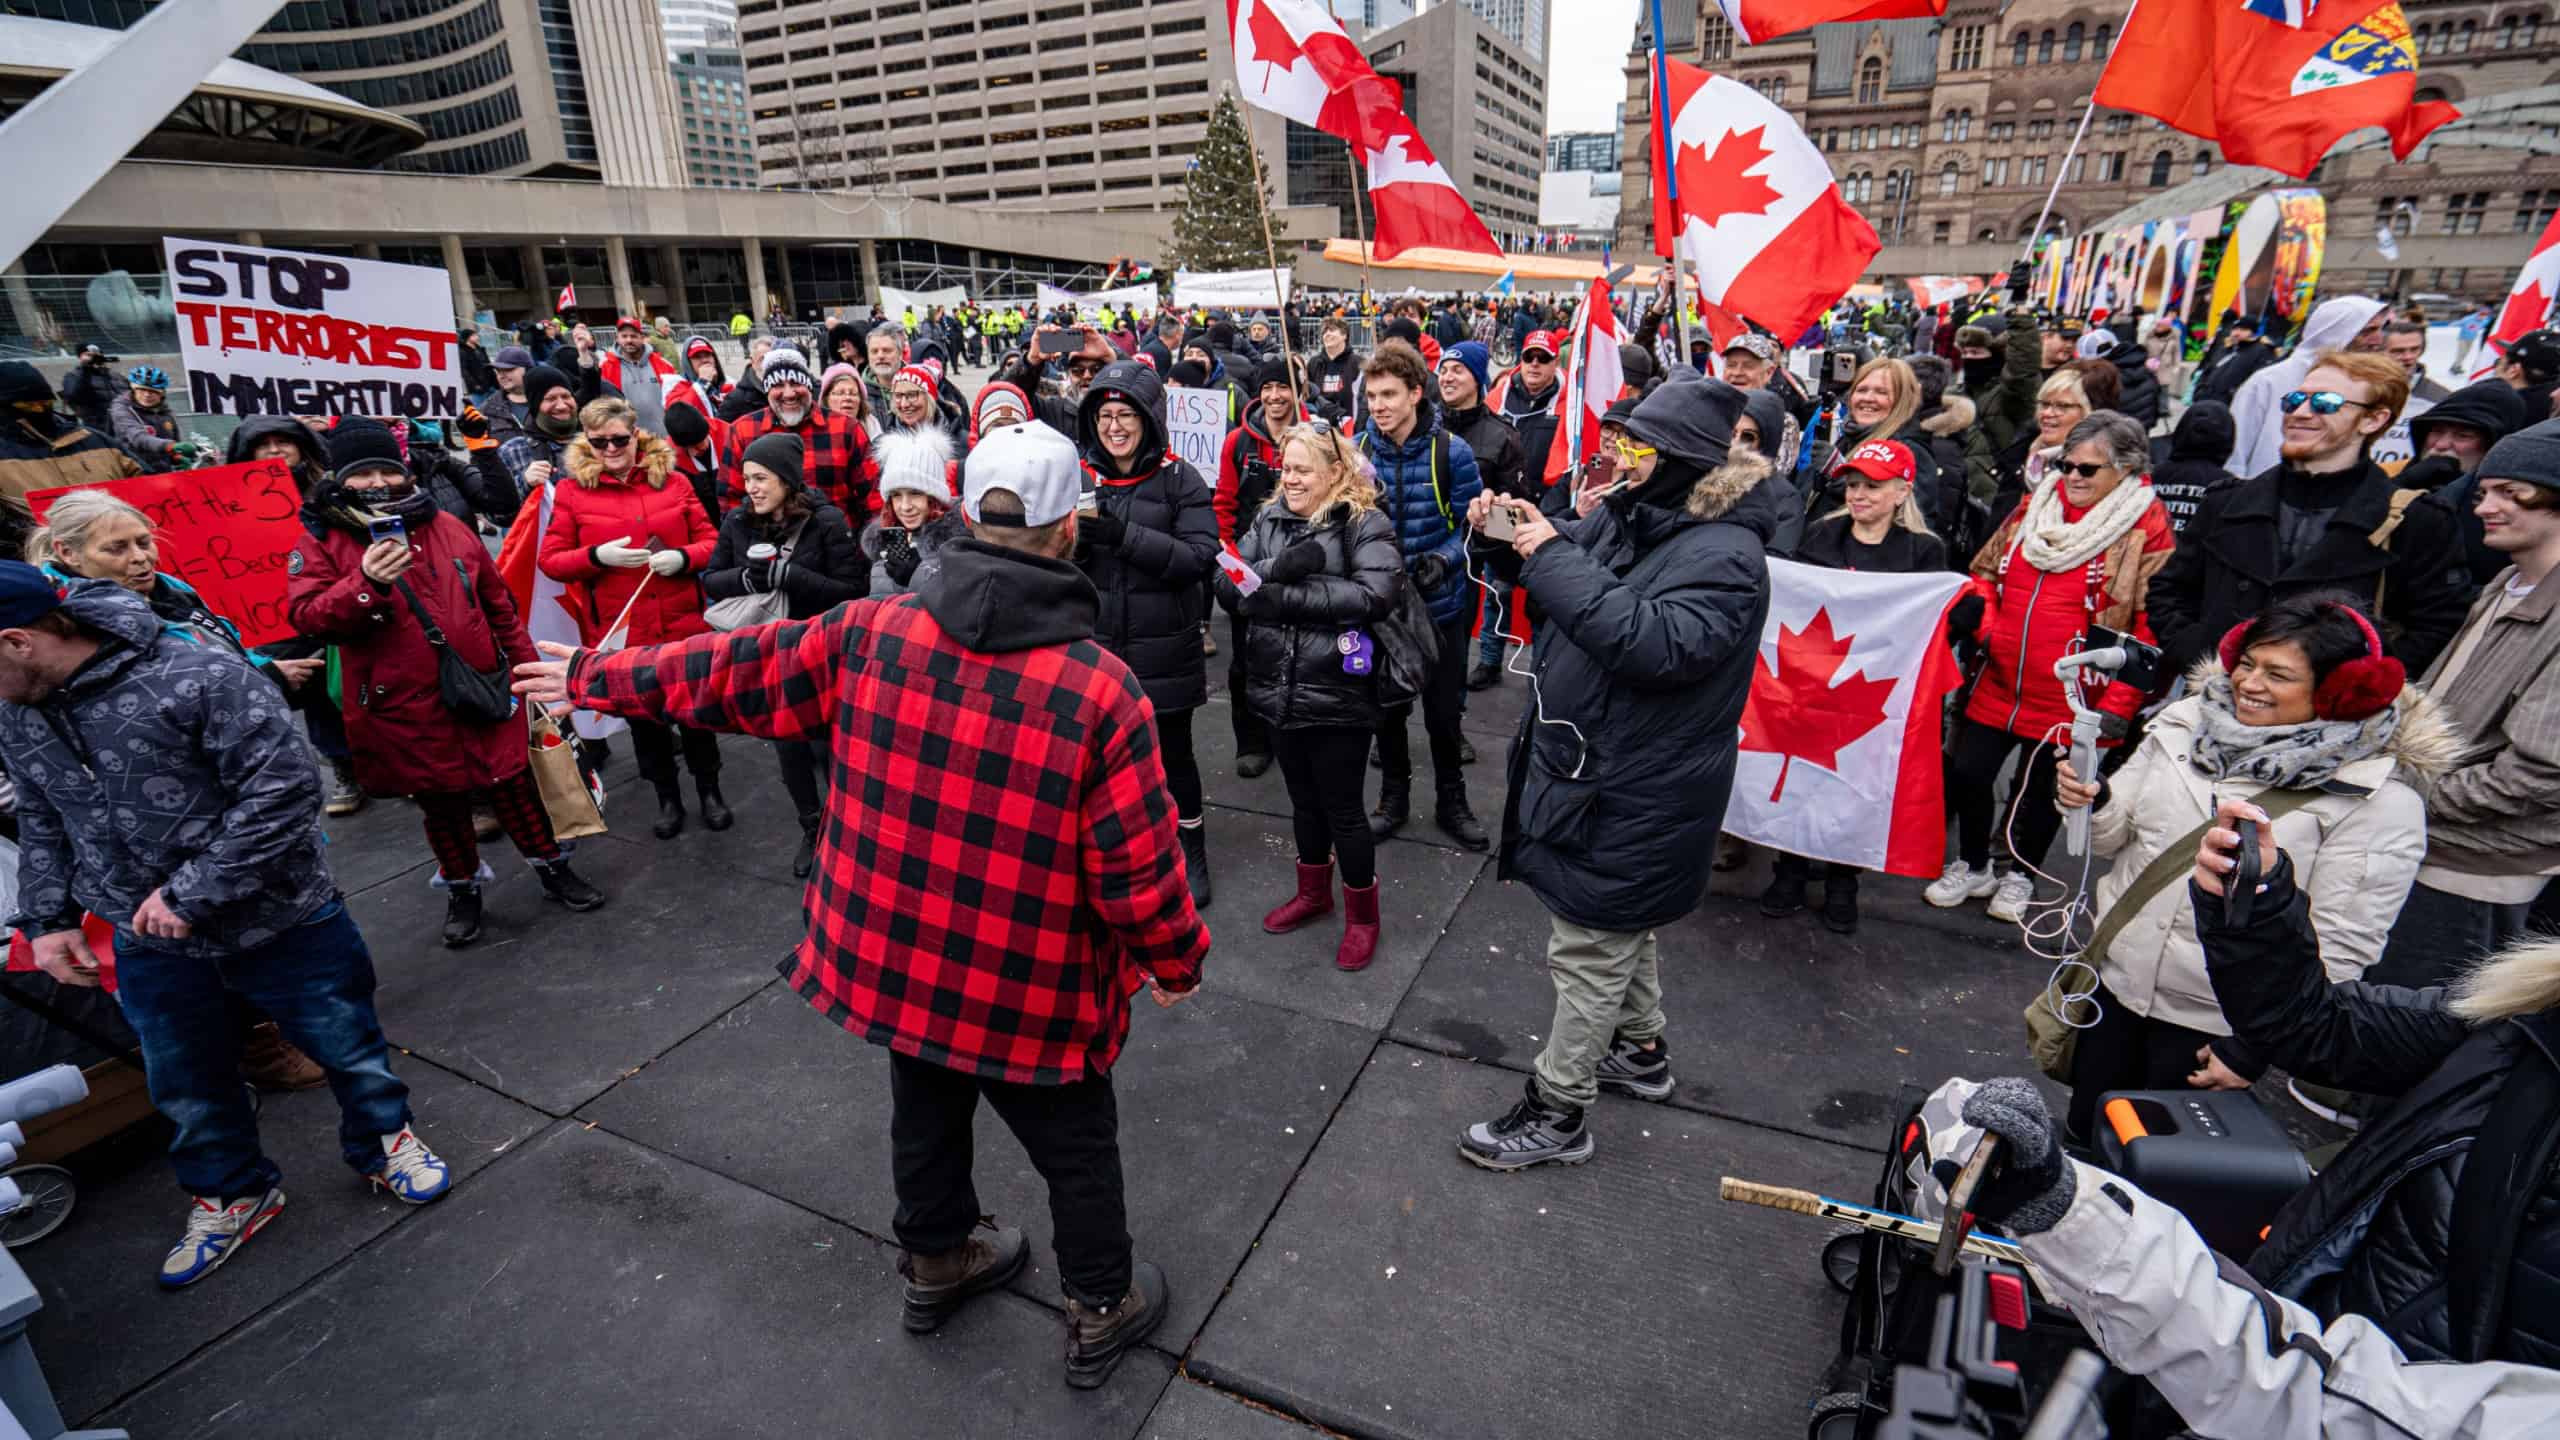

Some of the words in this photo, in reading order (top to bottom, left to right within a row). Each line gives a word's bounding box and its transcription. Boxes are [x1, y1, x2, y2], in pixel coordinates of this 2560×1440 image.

[175, 249, 350, 311] STOP
[176, 301, 458, 371] TERRORIST
[189, 369, 458, 417] IMMIGRATION
[762, 368, 813, 393] CANADA
